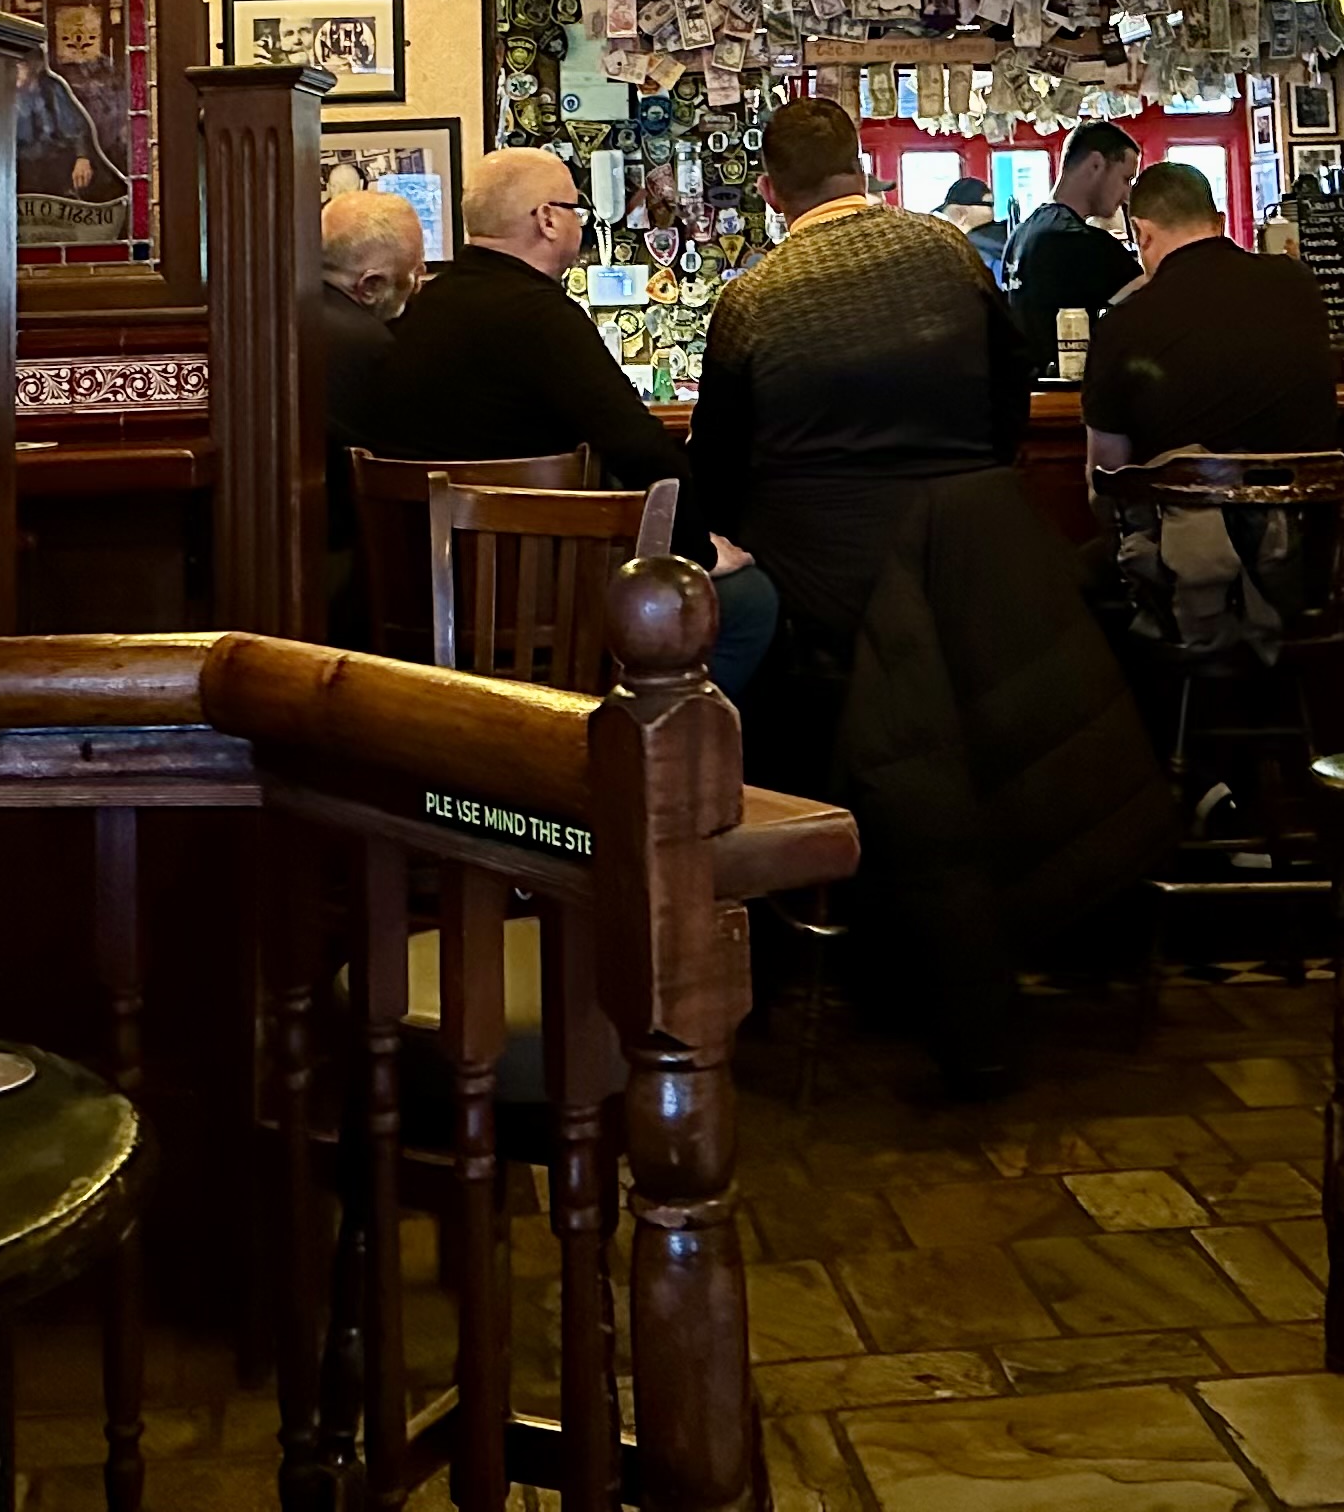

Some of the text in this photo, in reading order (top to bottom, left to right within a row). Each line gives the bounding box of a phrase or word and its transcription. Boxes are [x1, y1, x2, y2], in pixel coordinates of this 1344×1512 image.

[484, 805, 526, 837] MIND
[529, 816, 562, 847] THE
[565, 826, 593, 856] STE
